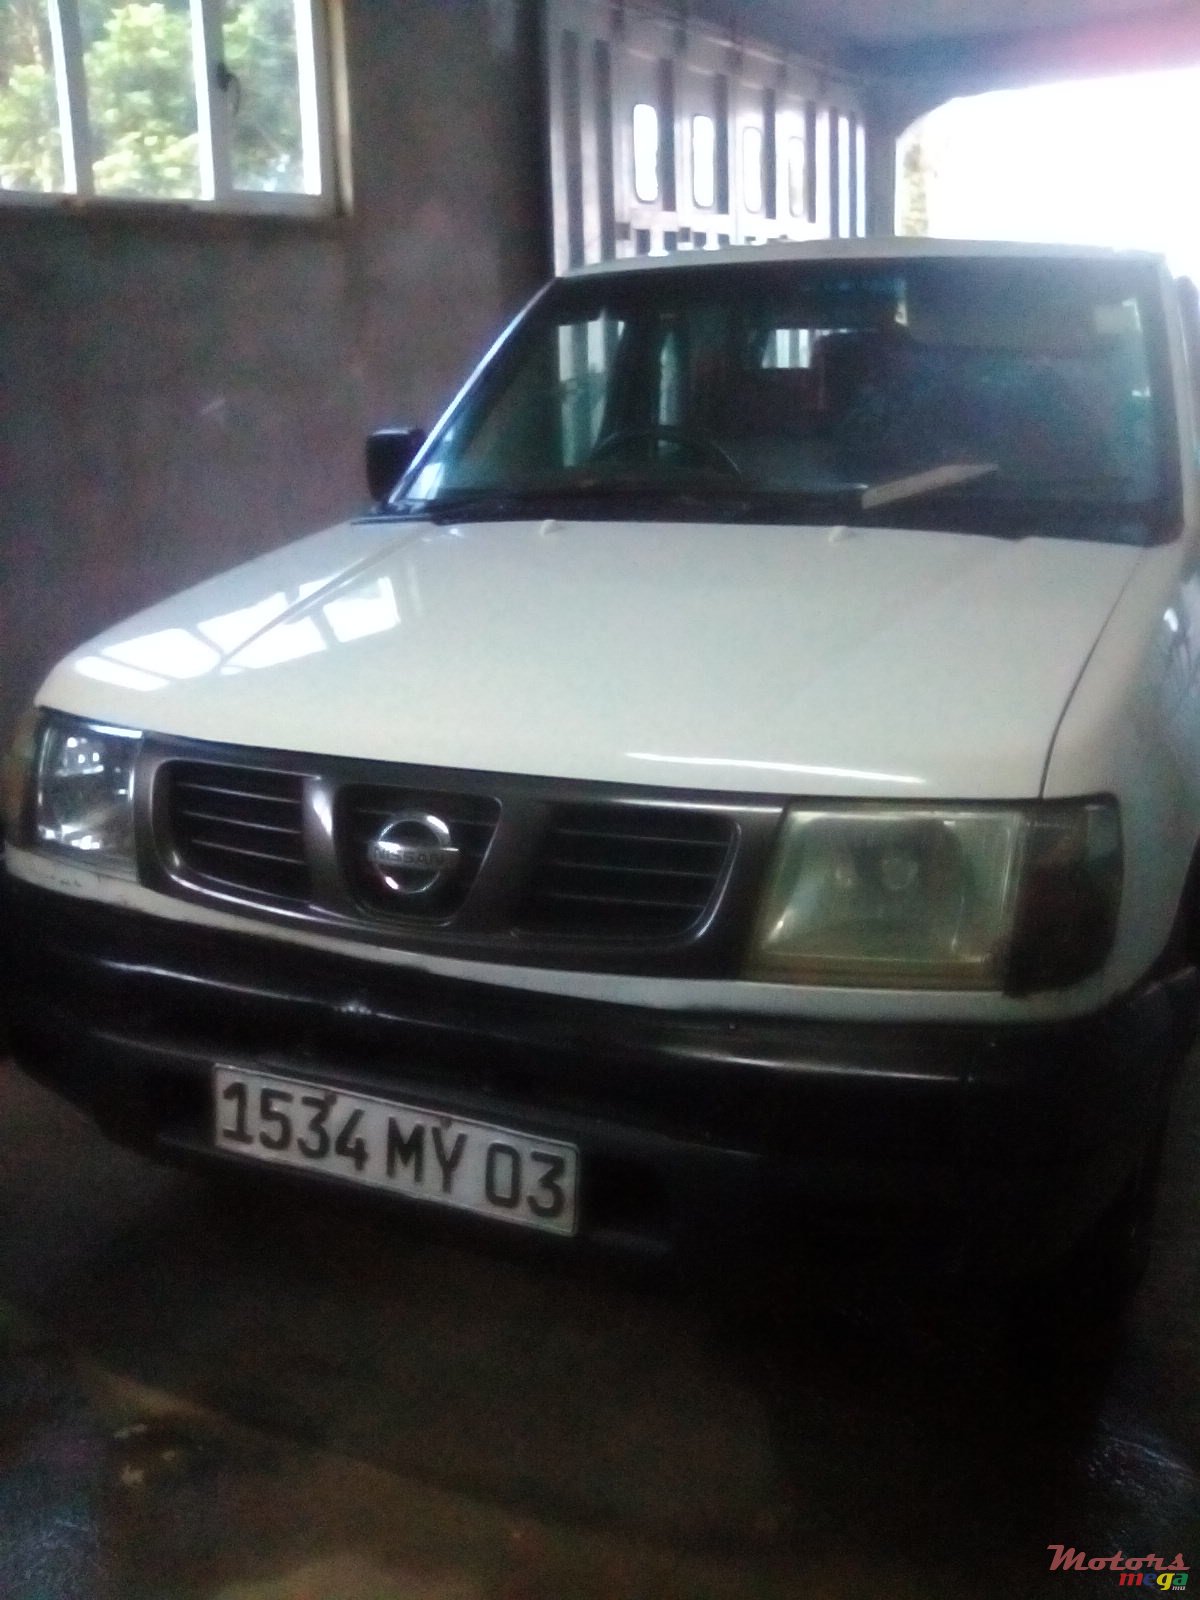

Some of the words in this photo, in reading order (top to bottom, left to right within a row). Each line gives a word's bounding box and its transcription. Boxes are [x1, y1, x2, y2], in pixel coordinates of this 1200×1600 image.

[222, 1082, 368, 1171] 1534
[386, 1117, 467, 1192] MY
[485, 1142, 566, 1218] 03
